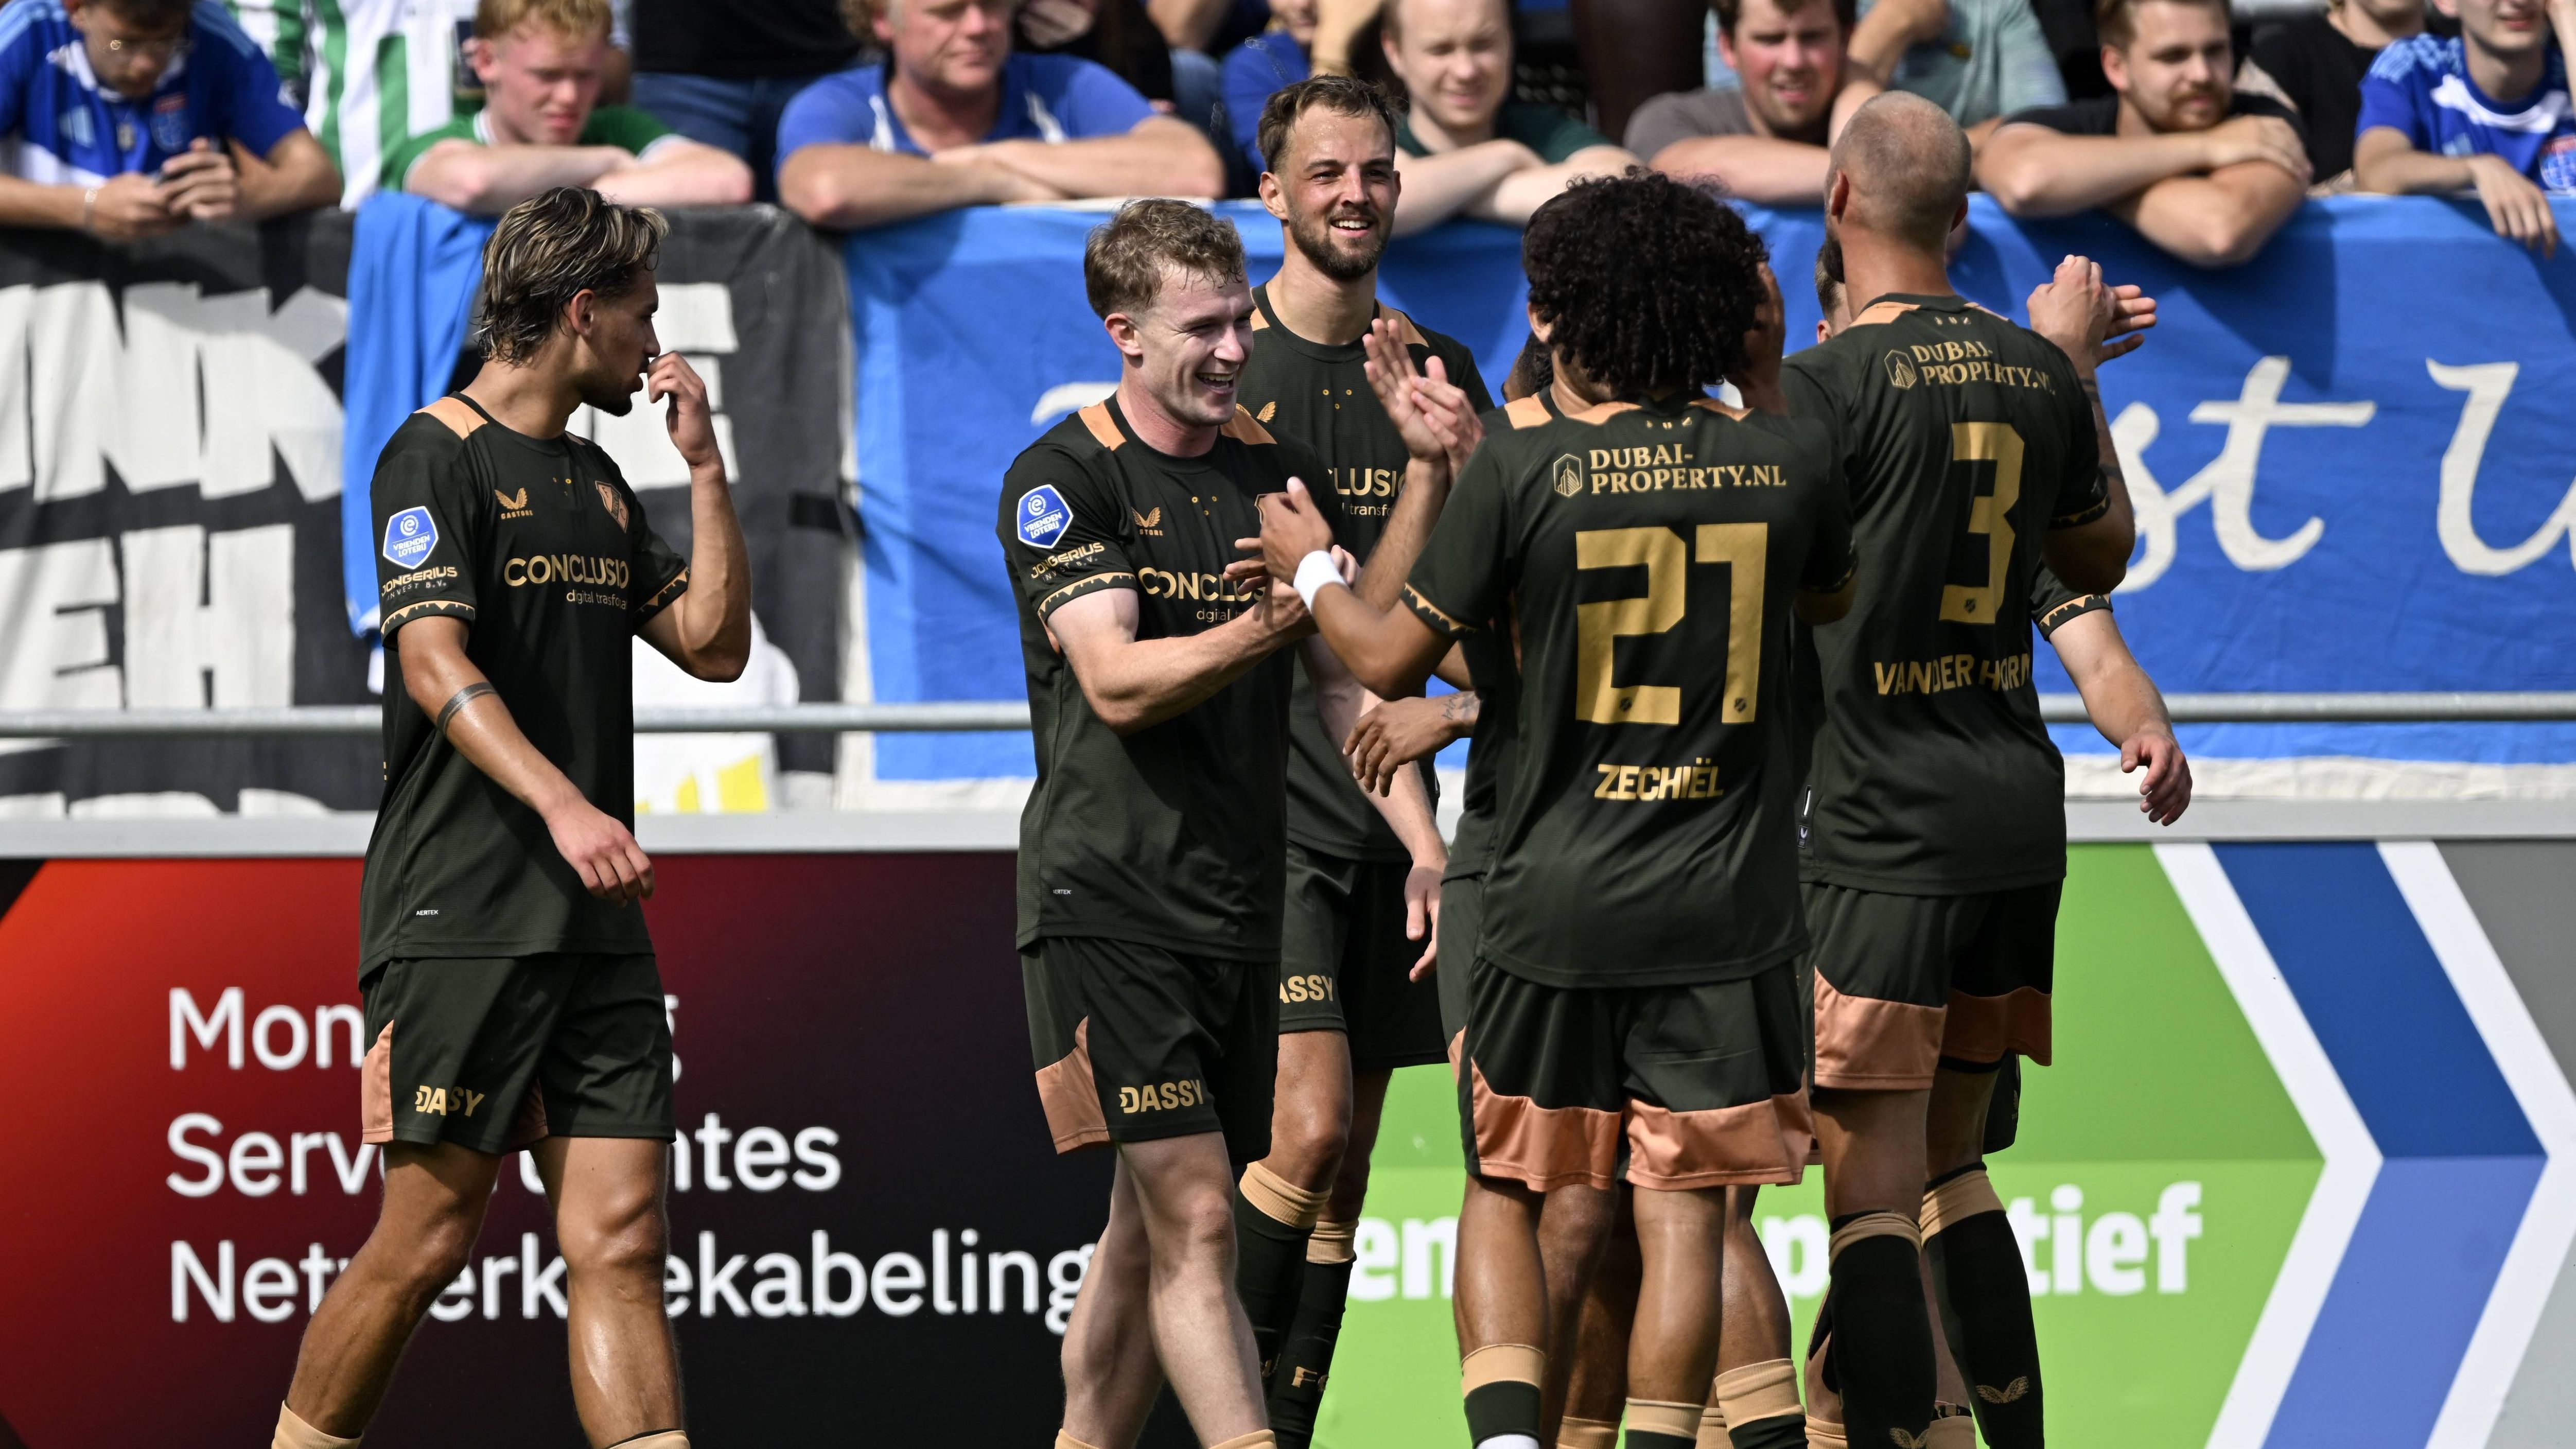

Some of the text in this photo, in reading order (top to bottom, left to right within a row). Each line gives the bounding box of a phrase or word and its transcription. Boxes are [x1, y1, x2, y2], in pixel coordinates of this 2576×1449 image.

[1589, 443, 1693, 469] DUBAI-
[1591, 465, 1786, 495] PROPERTY.NL
[1024, 512, 1062, 533] VRIENDEN
[1030, 520, 1060, 539] LOTERIJ
[1939, 422, 2024, 624] 3
[393, 534, 430, 551] VRIENDEN
[398, 543, 427, 558] LOTERIJ
[1031, 542, 1105, 579] JONGERIUS
[381, 566, 458, 597] JONGERIUS
[566, 588, 594, 605] dgital
[1575, 522, 1767, 725] 21
[1594, 757, 1724, 801] ZECHIËL
[1280, 975, 1334, 1004] ASSY
[1119, 1079, 1204, 1114] DASSY
